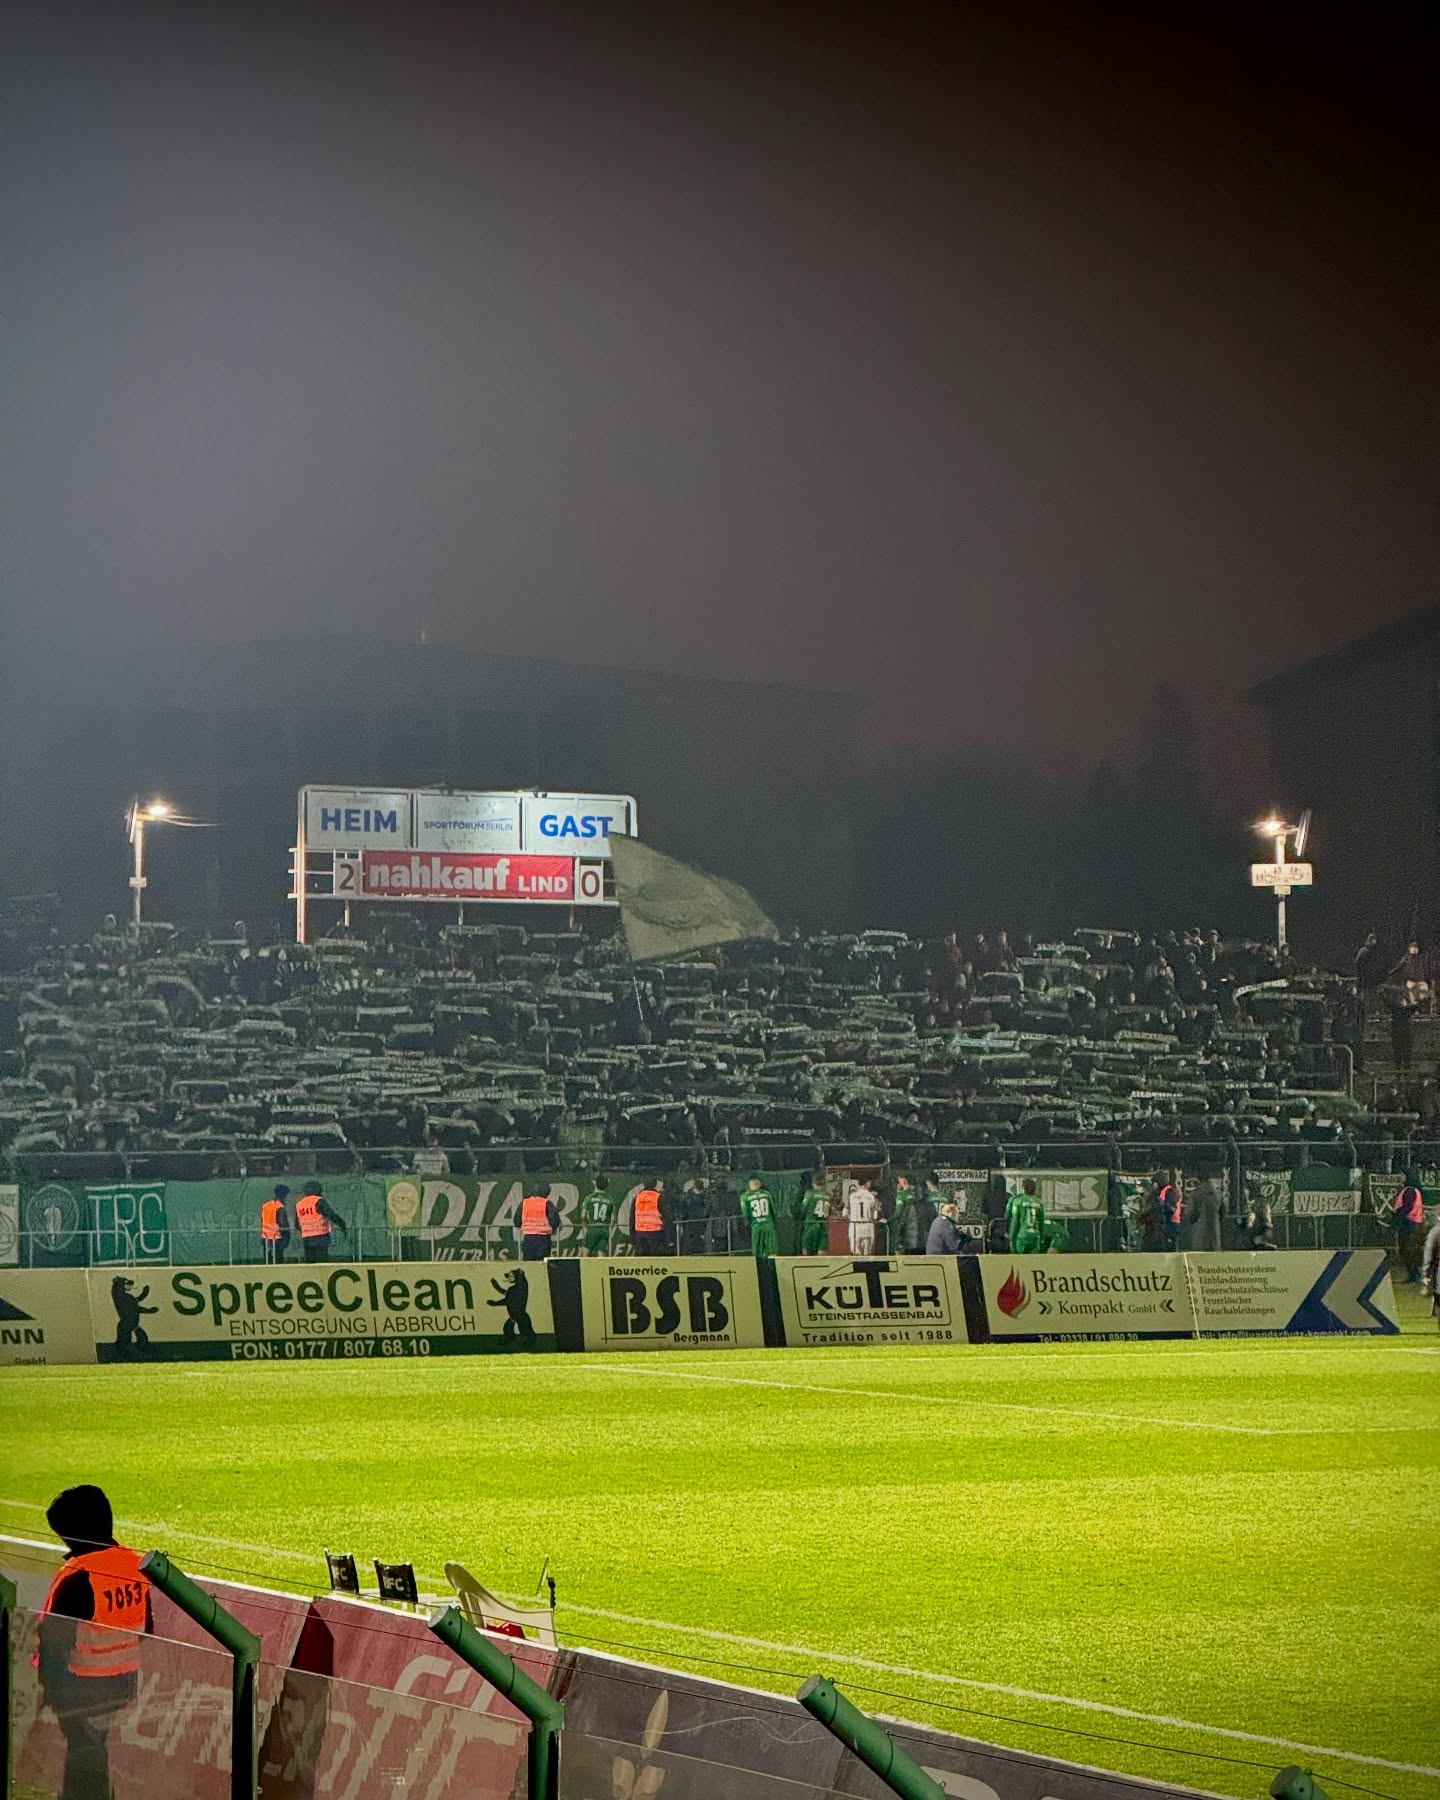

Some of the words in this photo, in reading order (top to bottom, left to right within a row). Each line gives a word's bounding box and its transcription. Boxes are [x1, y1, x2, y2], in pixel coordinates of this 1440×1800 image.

[321, 807, 397, 833] HEIM
[539, 815, 614, 838] GAST
[340, 863, 355, 891] 2
[369, 857, 510, 892] nahkauf
[518, 877, 568, 893] LIND
[581, 870, 600, 898] 0
[593, 1202, 608, 1221] 14
[750, 1199, 768, 1218] 30
[88, 1193, 165, 1257] TRC
[608, 1265, 669, 1276] Bauservice
[1031, 1268, 1173, 1294] Brandschutz
[1197, 1265, 1277, 1275] Brandschutzsysteme
[1199, 1275, 1269, 1286] Einblasdämmung
[804, 1261, 941, 1311] KÜTER
[172, 1269, 475, 1326] SpreeClean
[609, 1275, 729, 1335] BSB
[1202, 1295, 1252, 1305] Feuerlöscher
[808, 1310, 944, 1322] STEINSTRASSENBAU
[1058, 1300, 1124, 1319] Kompakt
[1128, 1304, 1157, 1314] GmbH
[1204, 1306, 1276, 1316] Rauchableitungen
[229, 1317, 368, 1337] ENTSORGUNG
[383, 1315, 476, 1333] ABBRUCH
[802, 1332, 874, 1344] Tradition
[881, 1330, 911, 1341] seit
[917, 1330, 953, 1341] 1988
[231, 1342, 279, 1360] FON:
[284, 1341, 327, 1359] 0177
[343, 1340, 374, 1357] 807
[381, 1338, 431, 1356] 68.10
[673, 1332, 730, 1344] Bergmann
